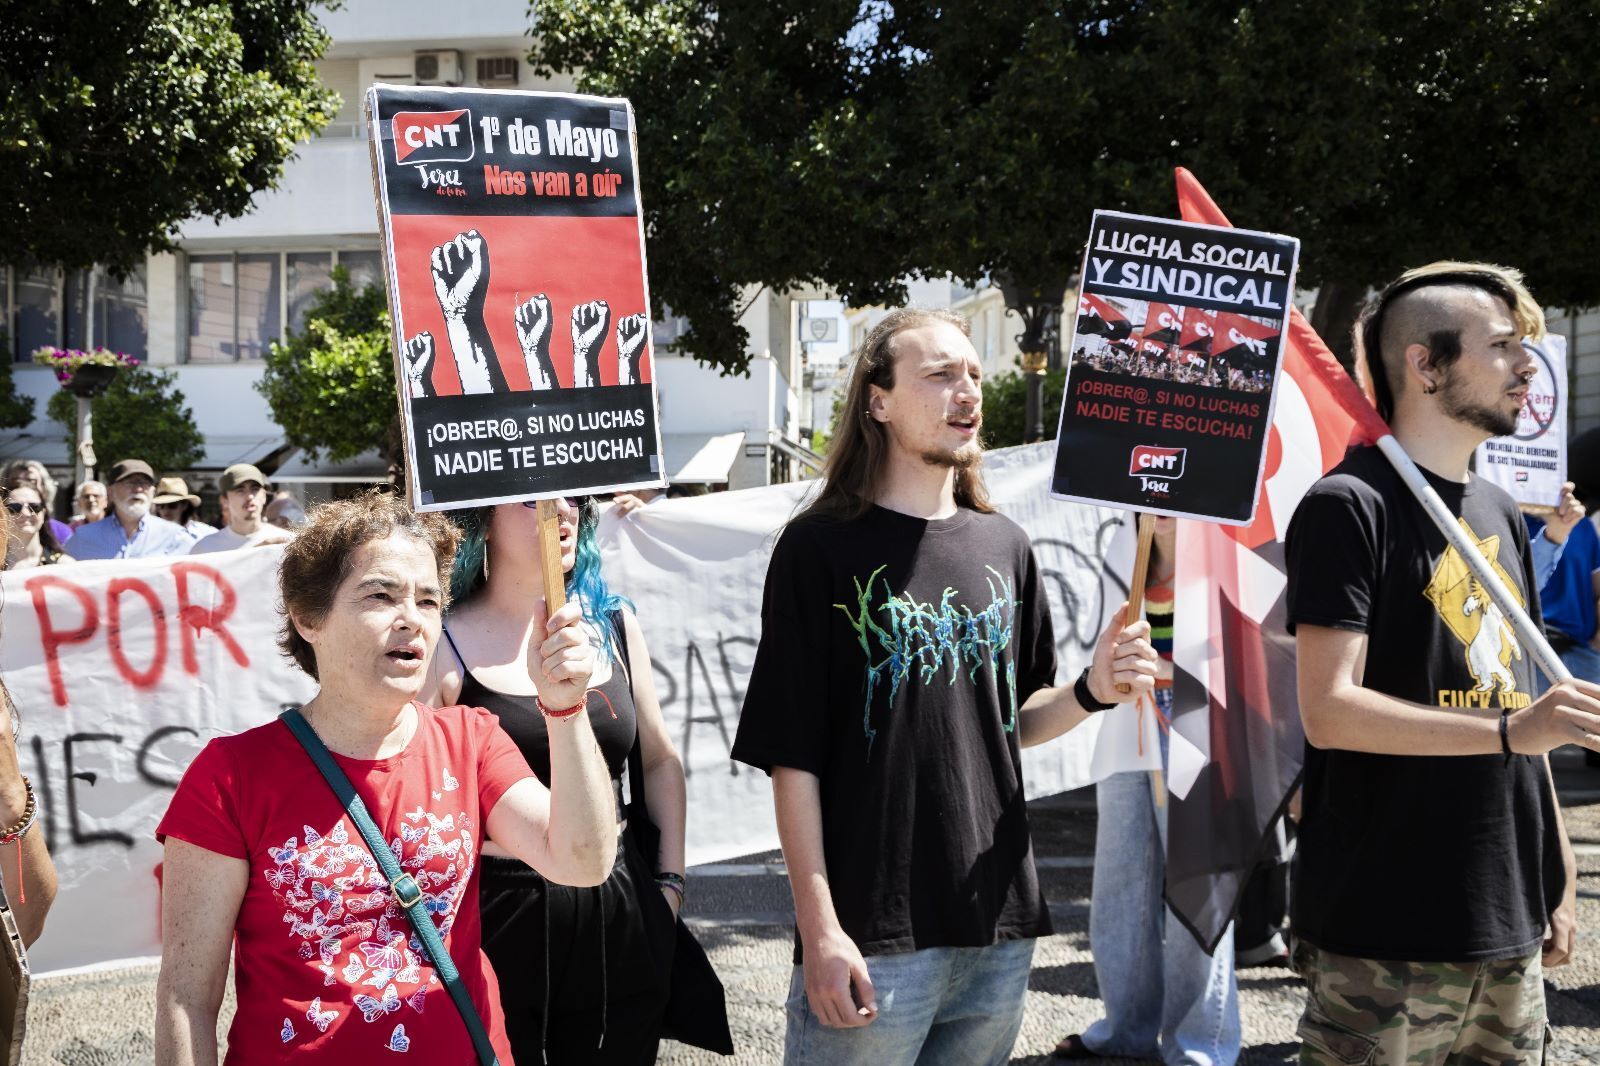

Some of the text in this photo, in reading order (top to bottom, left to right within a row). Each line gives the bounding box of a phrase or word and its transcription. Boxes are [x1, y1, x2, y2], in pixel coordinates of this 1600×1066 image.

[404, 124, 461, 148] CNT
[480, 116, 619, 163] 1º de Mayo
[484, 165, 623, 198] Nos van a oír
[1095, 229, 1286, 277] LUCHA SOCIAL
[1090, 257, 1281, 310] Y SINDICAL
[1076, 400, 1253, 440] NADIE TE ESCUCHA!
[1155, 390, 1170, 405] SI
[1173, 395, 1196, 408] NO
[1199, 399, 1261, 418] LUCHAS
[427, 408, 645, 448] ¡OBRER@, SI NO LUCHAS
[434, 436, 644, 476] NADIE TE ESCUCHA!
[1138, 453, 1177, 470] CNT
[25, 561, 250, 708] POR
